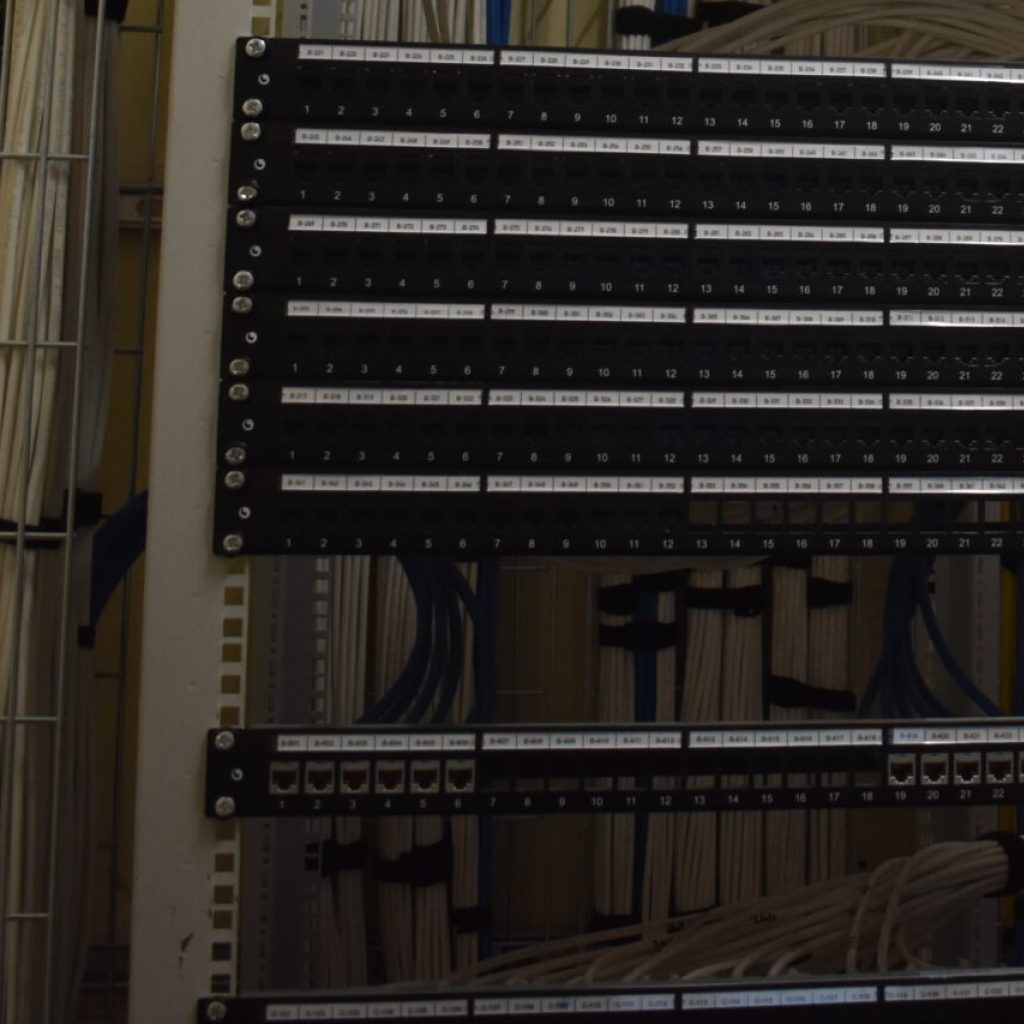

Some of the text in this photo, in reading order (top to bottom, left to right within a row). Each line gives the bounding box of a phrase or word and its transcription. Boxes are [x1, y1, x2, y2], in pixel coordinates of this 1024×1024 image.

[300, 190, 305, 199] 1
[334, 190, 341, 200] 2
[368, 191, 375, 201] 3
[402, 192, 409, 201] 4
[437, 193, 444, 202] 5
[470, 194, 477, 203] 6
[505, 194, 511, 203] 7
[538, 196, 545, 205] 8
[571, 197, 578, 206] 9
[603, 198, 615, 207] 10
[637, 199, 646, 207] 11
[670, 200, 681, 208] 12
[703, 200, 714, 210] 13
[736, 201, 746, 209] 14
[768, 201, 780, 211] 15
[801, 202, 812, 211] 16
[833, 202, 844, 211] 17
[866, 203, 876, 212] 18
[898, 204, 909, 213] 19
[929, 204, 940, 214] 20
[960, 205, 971, 214] 21
[992, 205, 1004, 215] 22
[292, 363, 298, 372] 1
[326, 363, 333, 373] 2
[361, 364, 368, 374] 3
[396, 365, 402, 373] 4
[430, 364, 437, 374] 5
[464, 366, 471, 375] 6
[499, 366, 505, 374] 7
[532, 367, 539, 376] 8
[566, 367, 573, 376] 9
[598, 368, 610, 377] 10
[632, 368, 642, 377] 11
[666, 368, 677, 378] 12
[699, 369, 710, 378] 13
[732, 370, 743, 378] 14
[765, 370, 776, 379] 15
[798, 370, 809, 379] 16
[831, 370, 842, 378] 17
[864, 370, 874, 380] 18
[896, 370, 907, 380] 19
[927, 370, 939, 380] 20
[959, 370, 970, 380] 21
[991, 370, 1003, 380] 22
[524, 797, 532, 807] 8
[559, 797, 566, 807] 9
[592, 797, 603, 806] 10
[626, 796, 636, 805] 11
[660, 796, 672, 806] 12
[694, 795, 706, 804] 13
[728, 795, 739, 803] 14
[762, 794, 773, 803] 15
[795, 793, 806, 802] 16
[829, 792, 840, 801] 17
[862, 791, 873, 801] 18
[895, 790, 906, 800] 19
[927, 790, 940, 800] 20
[960, 790, 971, 799] 21
[992, 788, 1004, 798] 22
